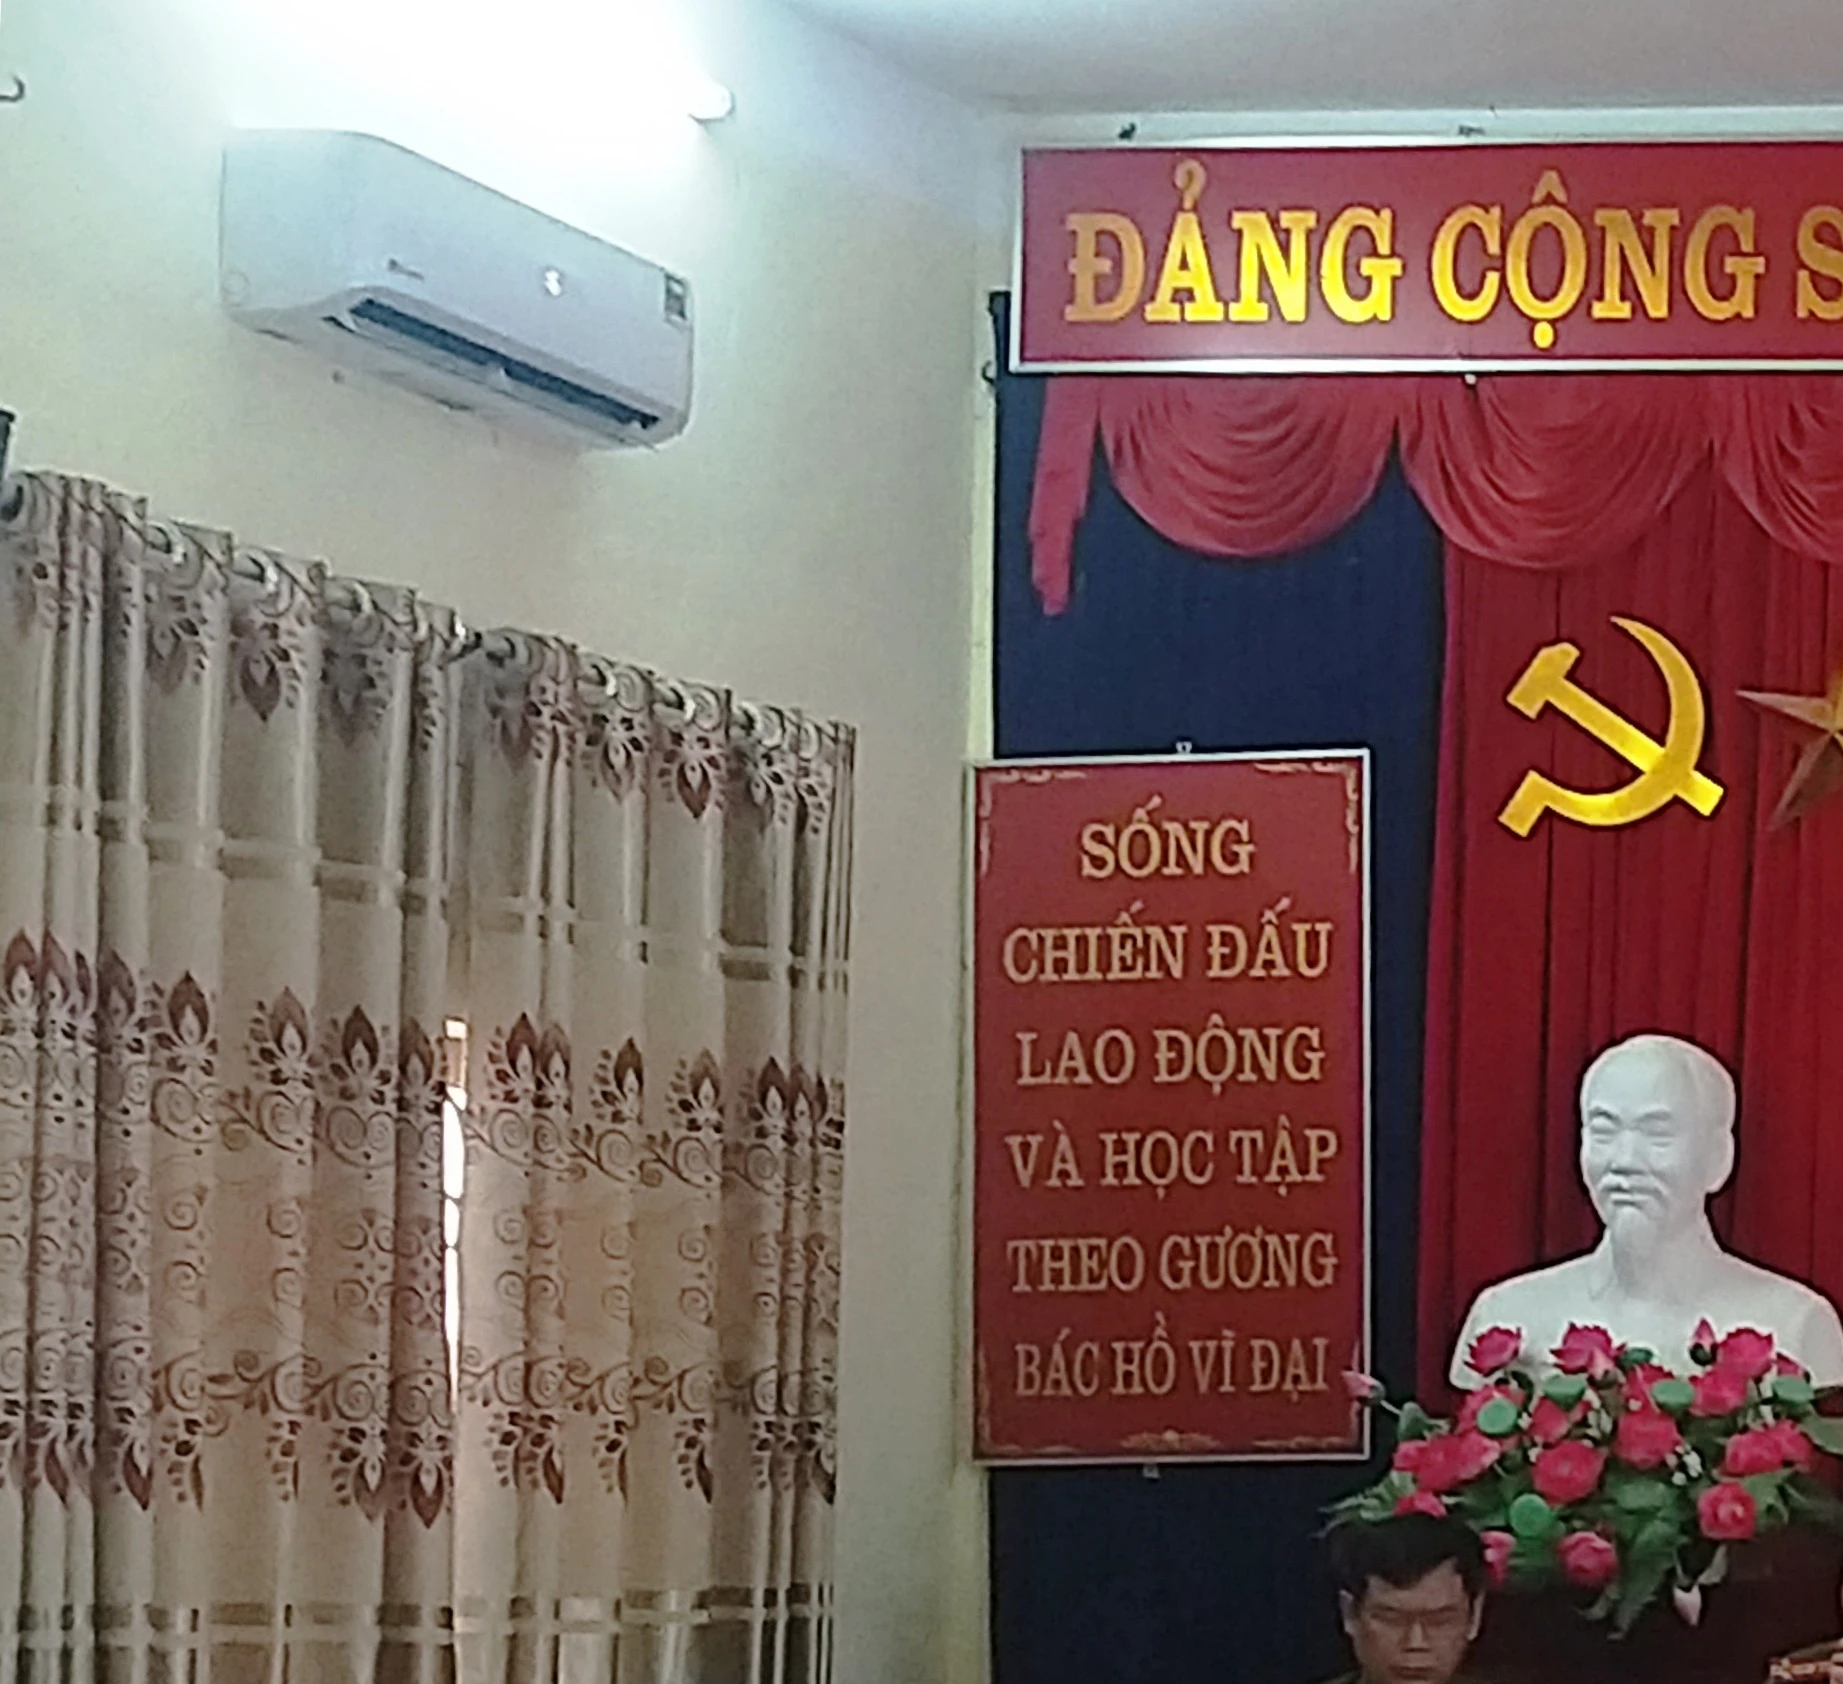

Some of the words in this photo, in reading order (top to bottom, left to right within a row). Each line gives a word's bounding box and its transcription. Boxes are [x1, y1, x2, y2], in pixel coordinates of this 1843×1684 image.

[1066, 160, 1402, 323] ĐẢNG
[1430, 174, 1764, 348] CỘNG
[1082, 796, 1255, 877] SỐNG
[1004, 901, 1187, 982] CHIẾN
[1207, 898, 1332, 977] ĐẤU
[1016, 1030, 1134, 1084] LAO
[1154, 1014, 1325, 1094] ĐỘNG
[1005, 1120, 1084, 1187] VÀ
[1100, 1131, 1213, 1198] HỌC
[1230, 1115, 1337, 1196] TẬP
[1007, 1236, 1144, 1291] THEO
[1160, 1226, 1337, 1289] GƯƠNG
[1015, 1328, 1099, 1396] BÁC
[1112, 1312, 1175, 1394] HỒ
[1250, 1337, 1329, 1402] ĐẠI
